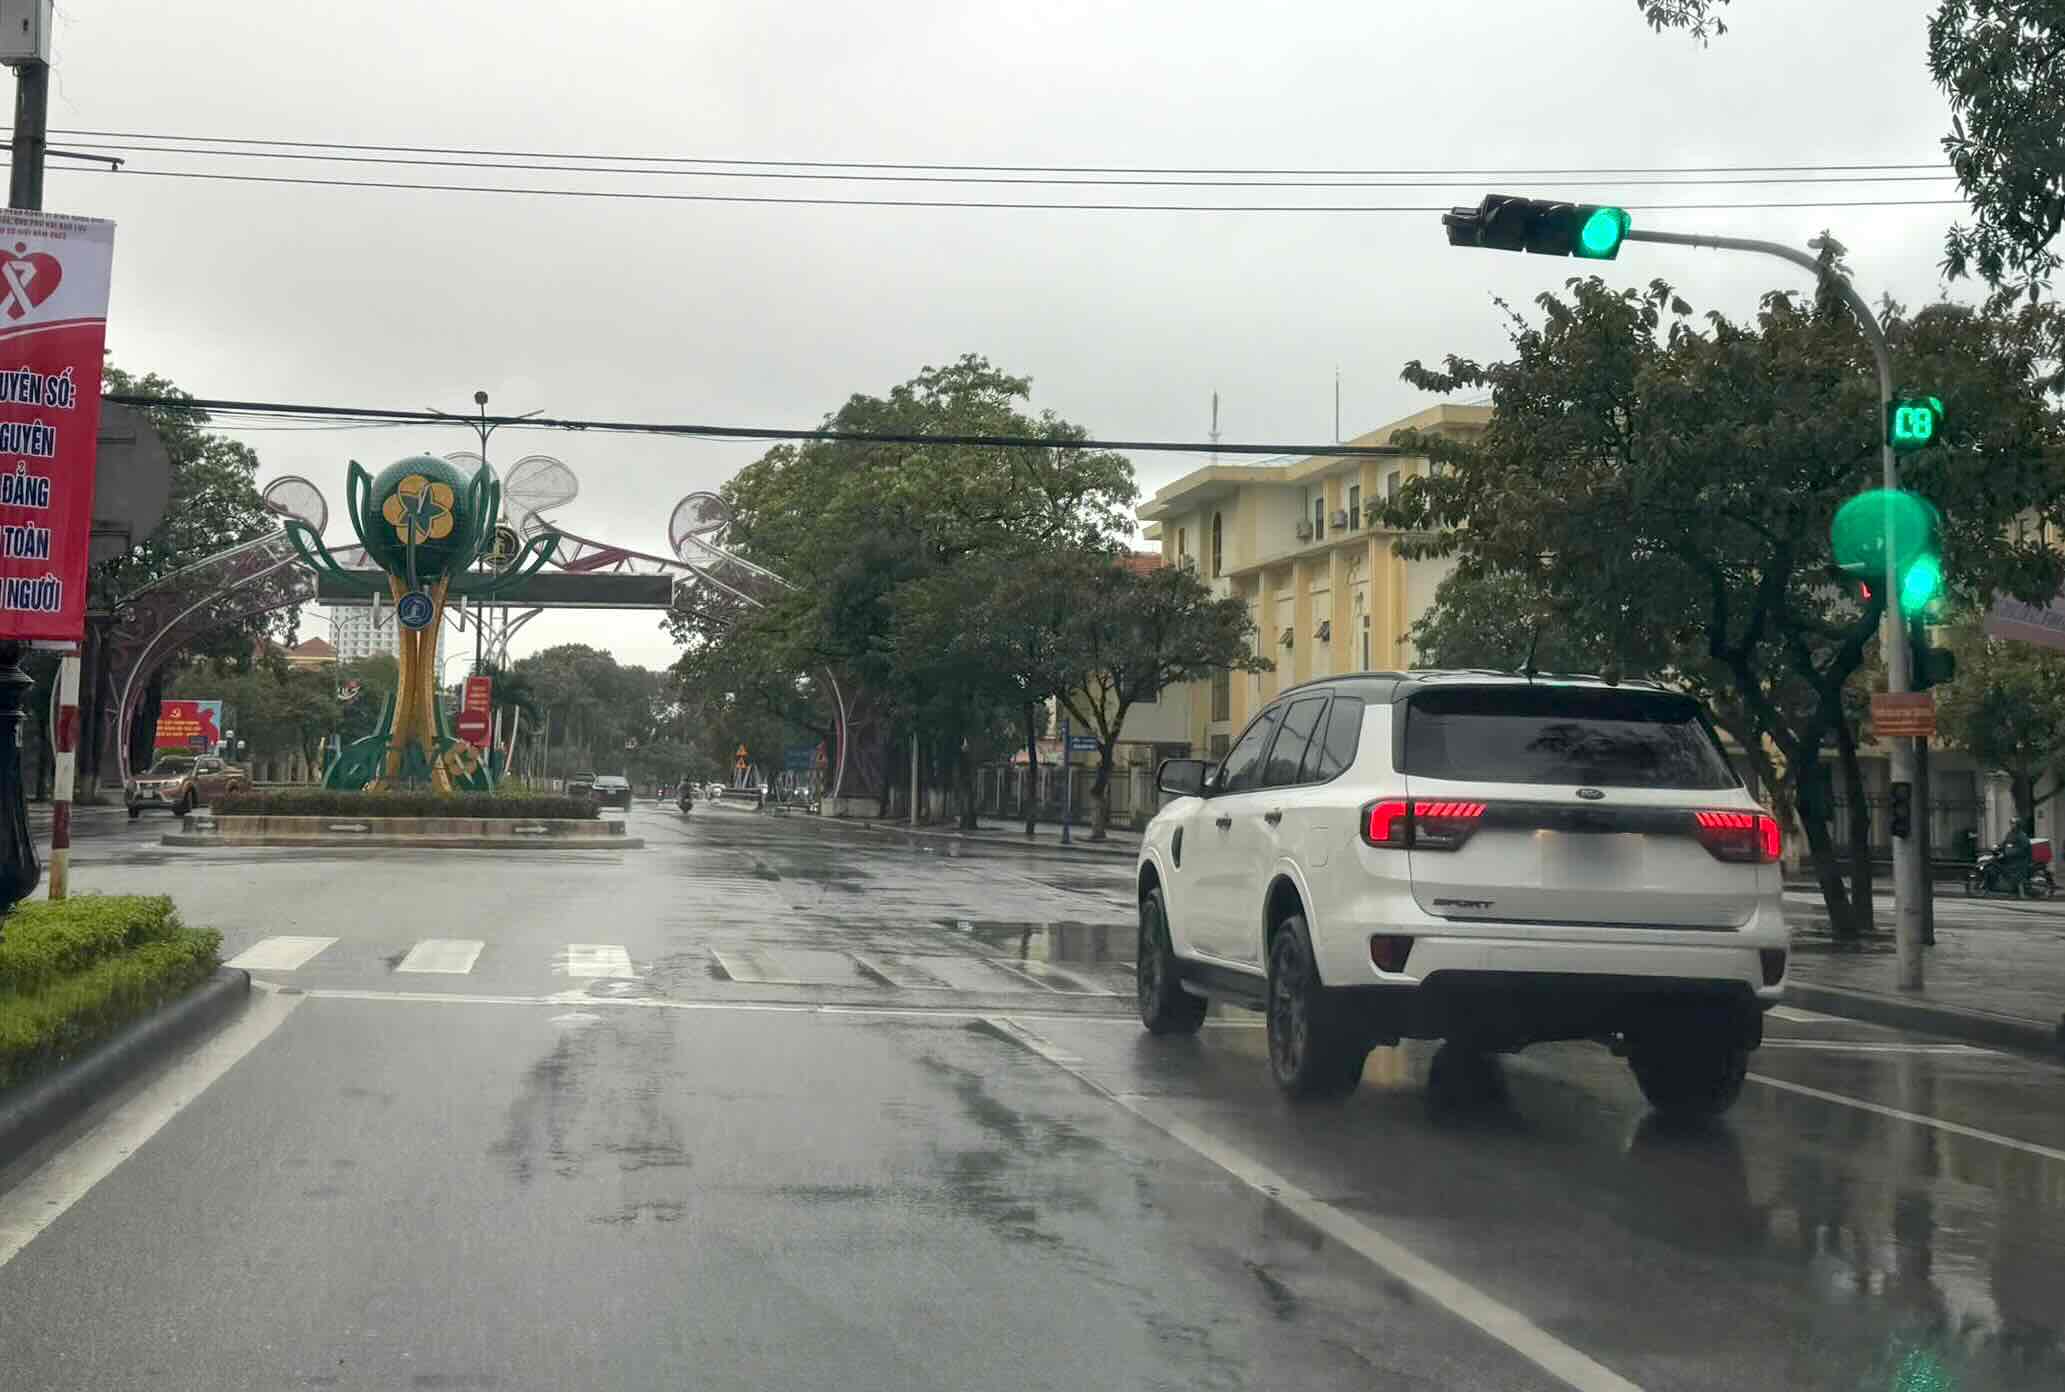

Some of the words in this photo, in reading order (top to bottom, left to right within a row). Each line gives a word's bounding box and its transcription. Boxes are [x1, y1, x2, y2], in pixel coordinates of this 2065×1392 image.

[46, 366, 76, 409] SỐ:
[2, 460, 49, 508] ĐẲNG
[4, 521, 50, 560] TOÀN
[6, 572, 62, 612] NGƯỜI
